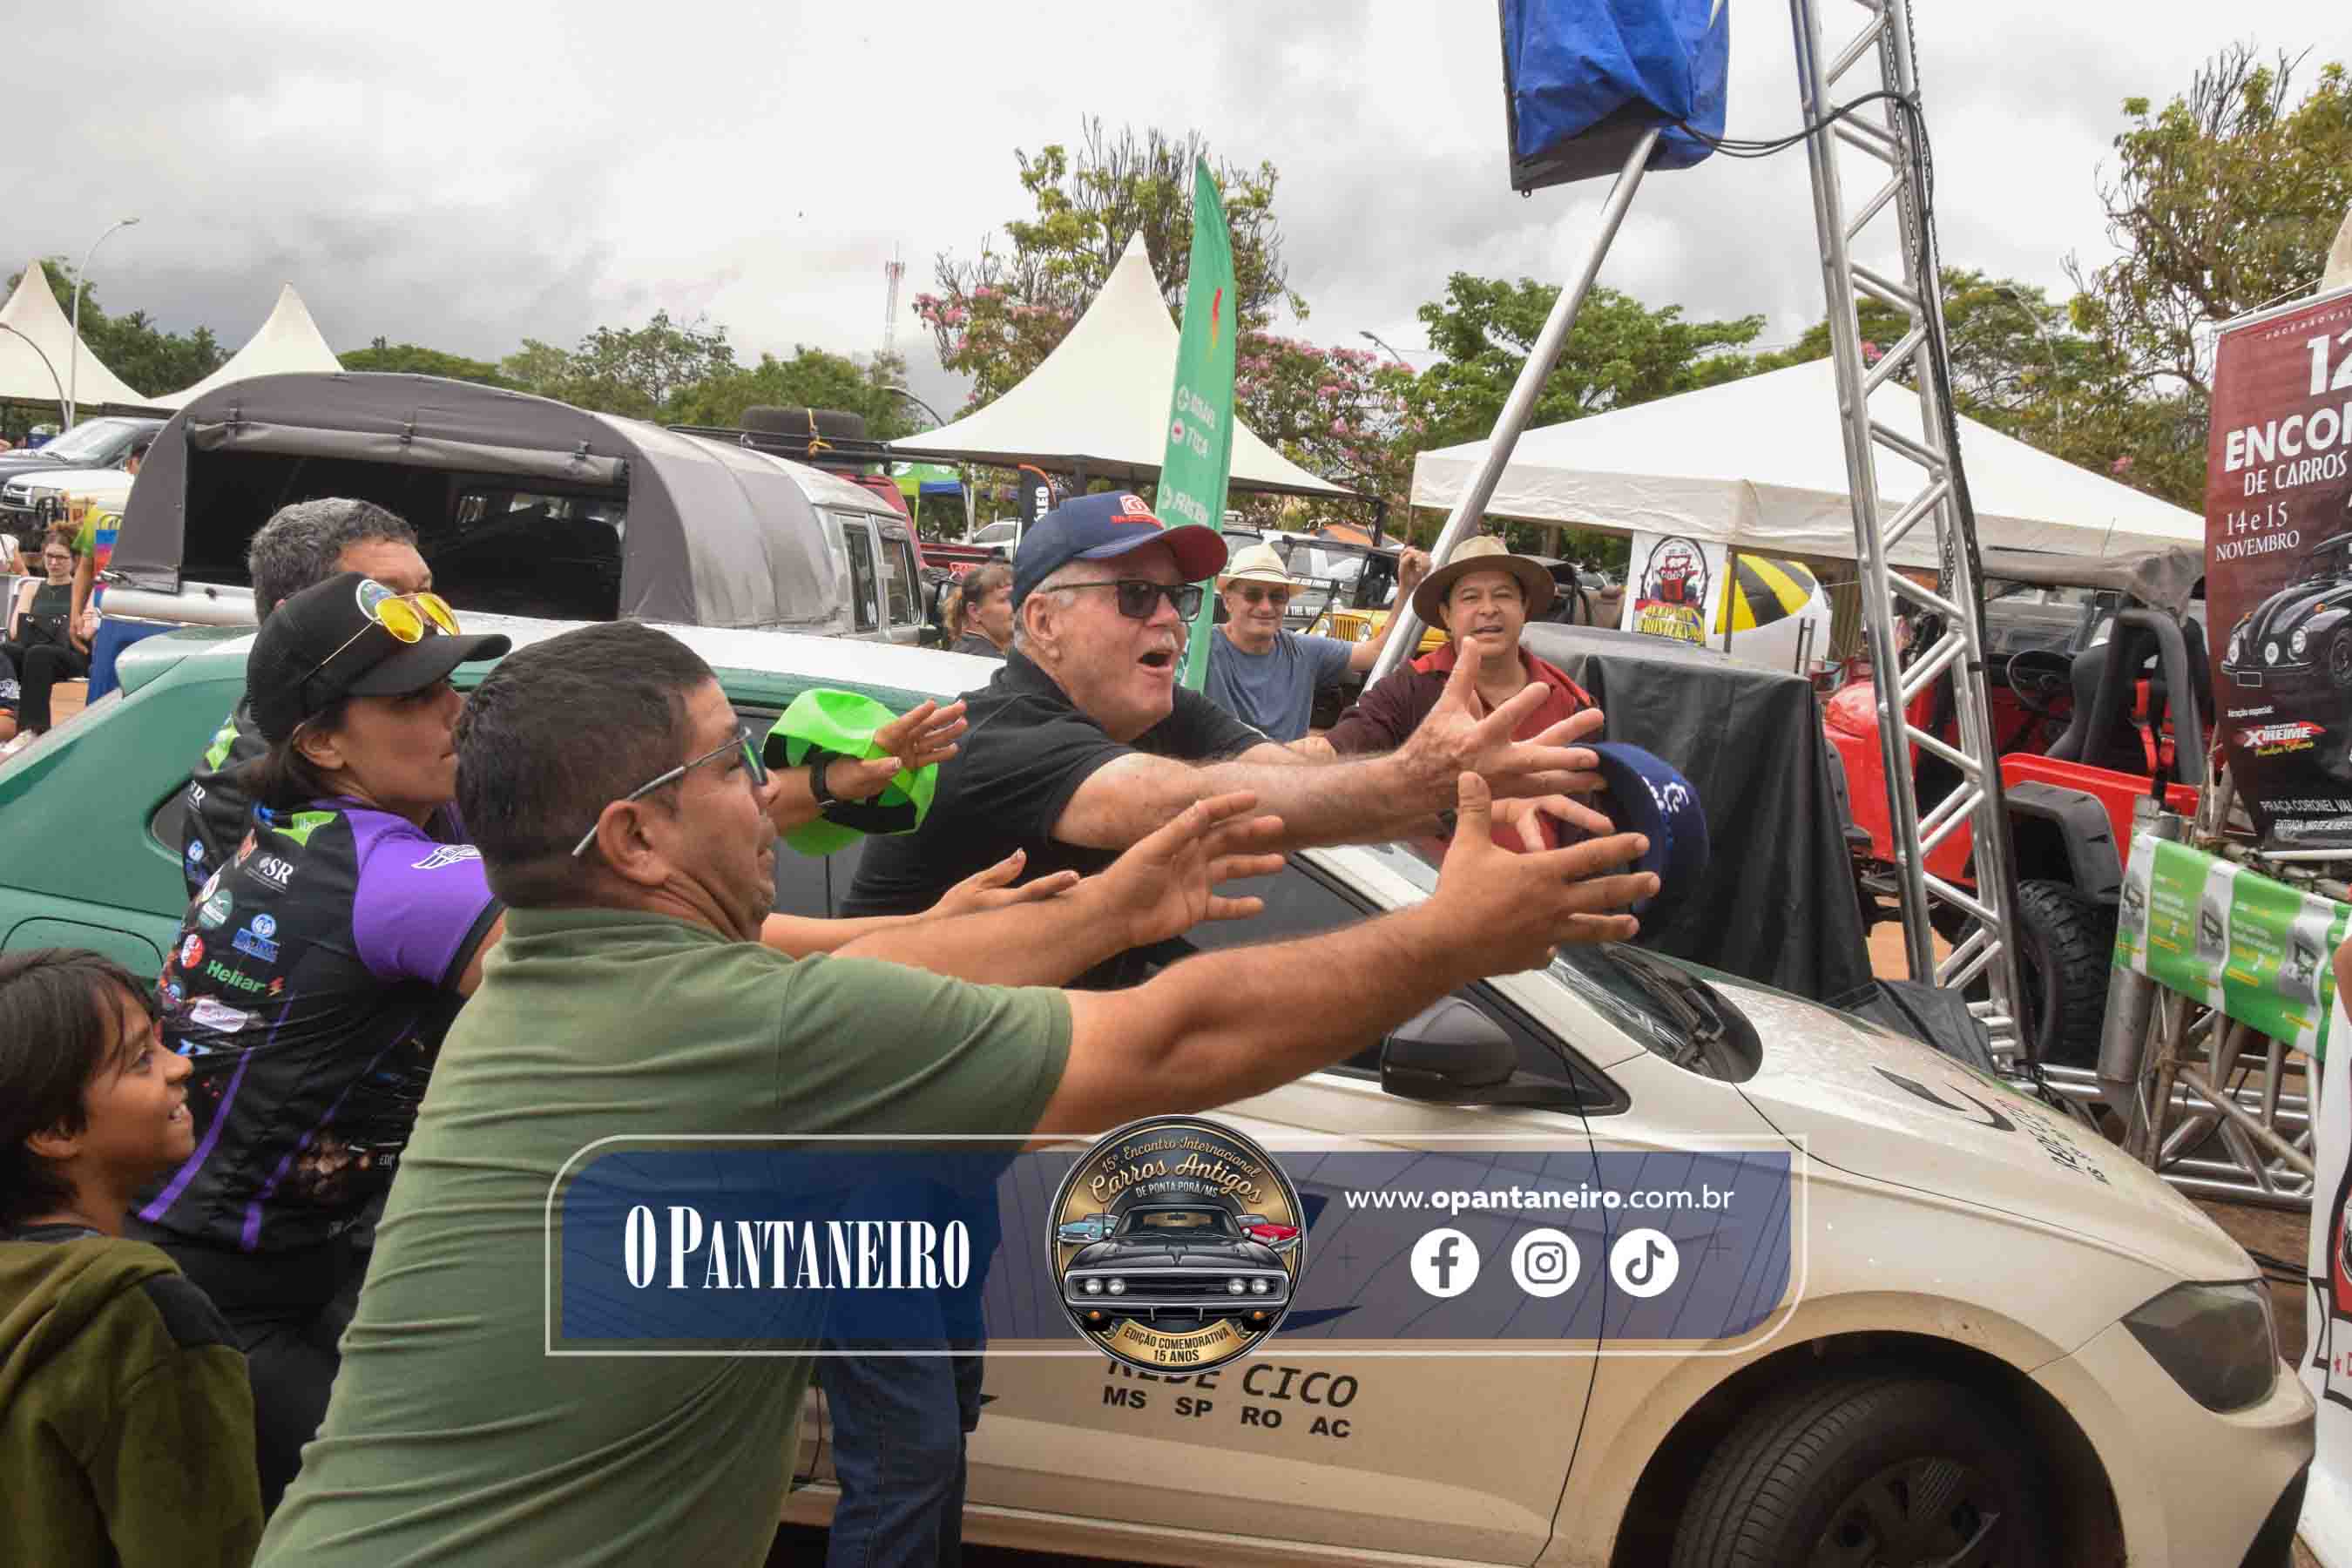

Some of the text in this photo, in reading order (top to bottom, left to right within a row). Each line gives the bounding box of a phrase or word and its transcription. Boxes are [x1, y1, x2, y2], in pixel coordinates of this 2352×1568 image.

[2243, 449, 2349, 497] DE CARROS
[2227, 501, 2288, 537] 14 e 15
[2215, 529, 2301, 563] NOVEMBRO
[265, 857, 294, 884] SR
[206, 959, 266, 992] Heliar
[1242, 1363, 1359, 1408] CICO
[1103, 1385, 1351, 1438] MS SP RO AC
